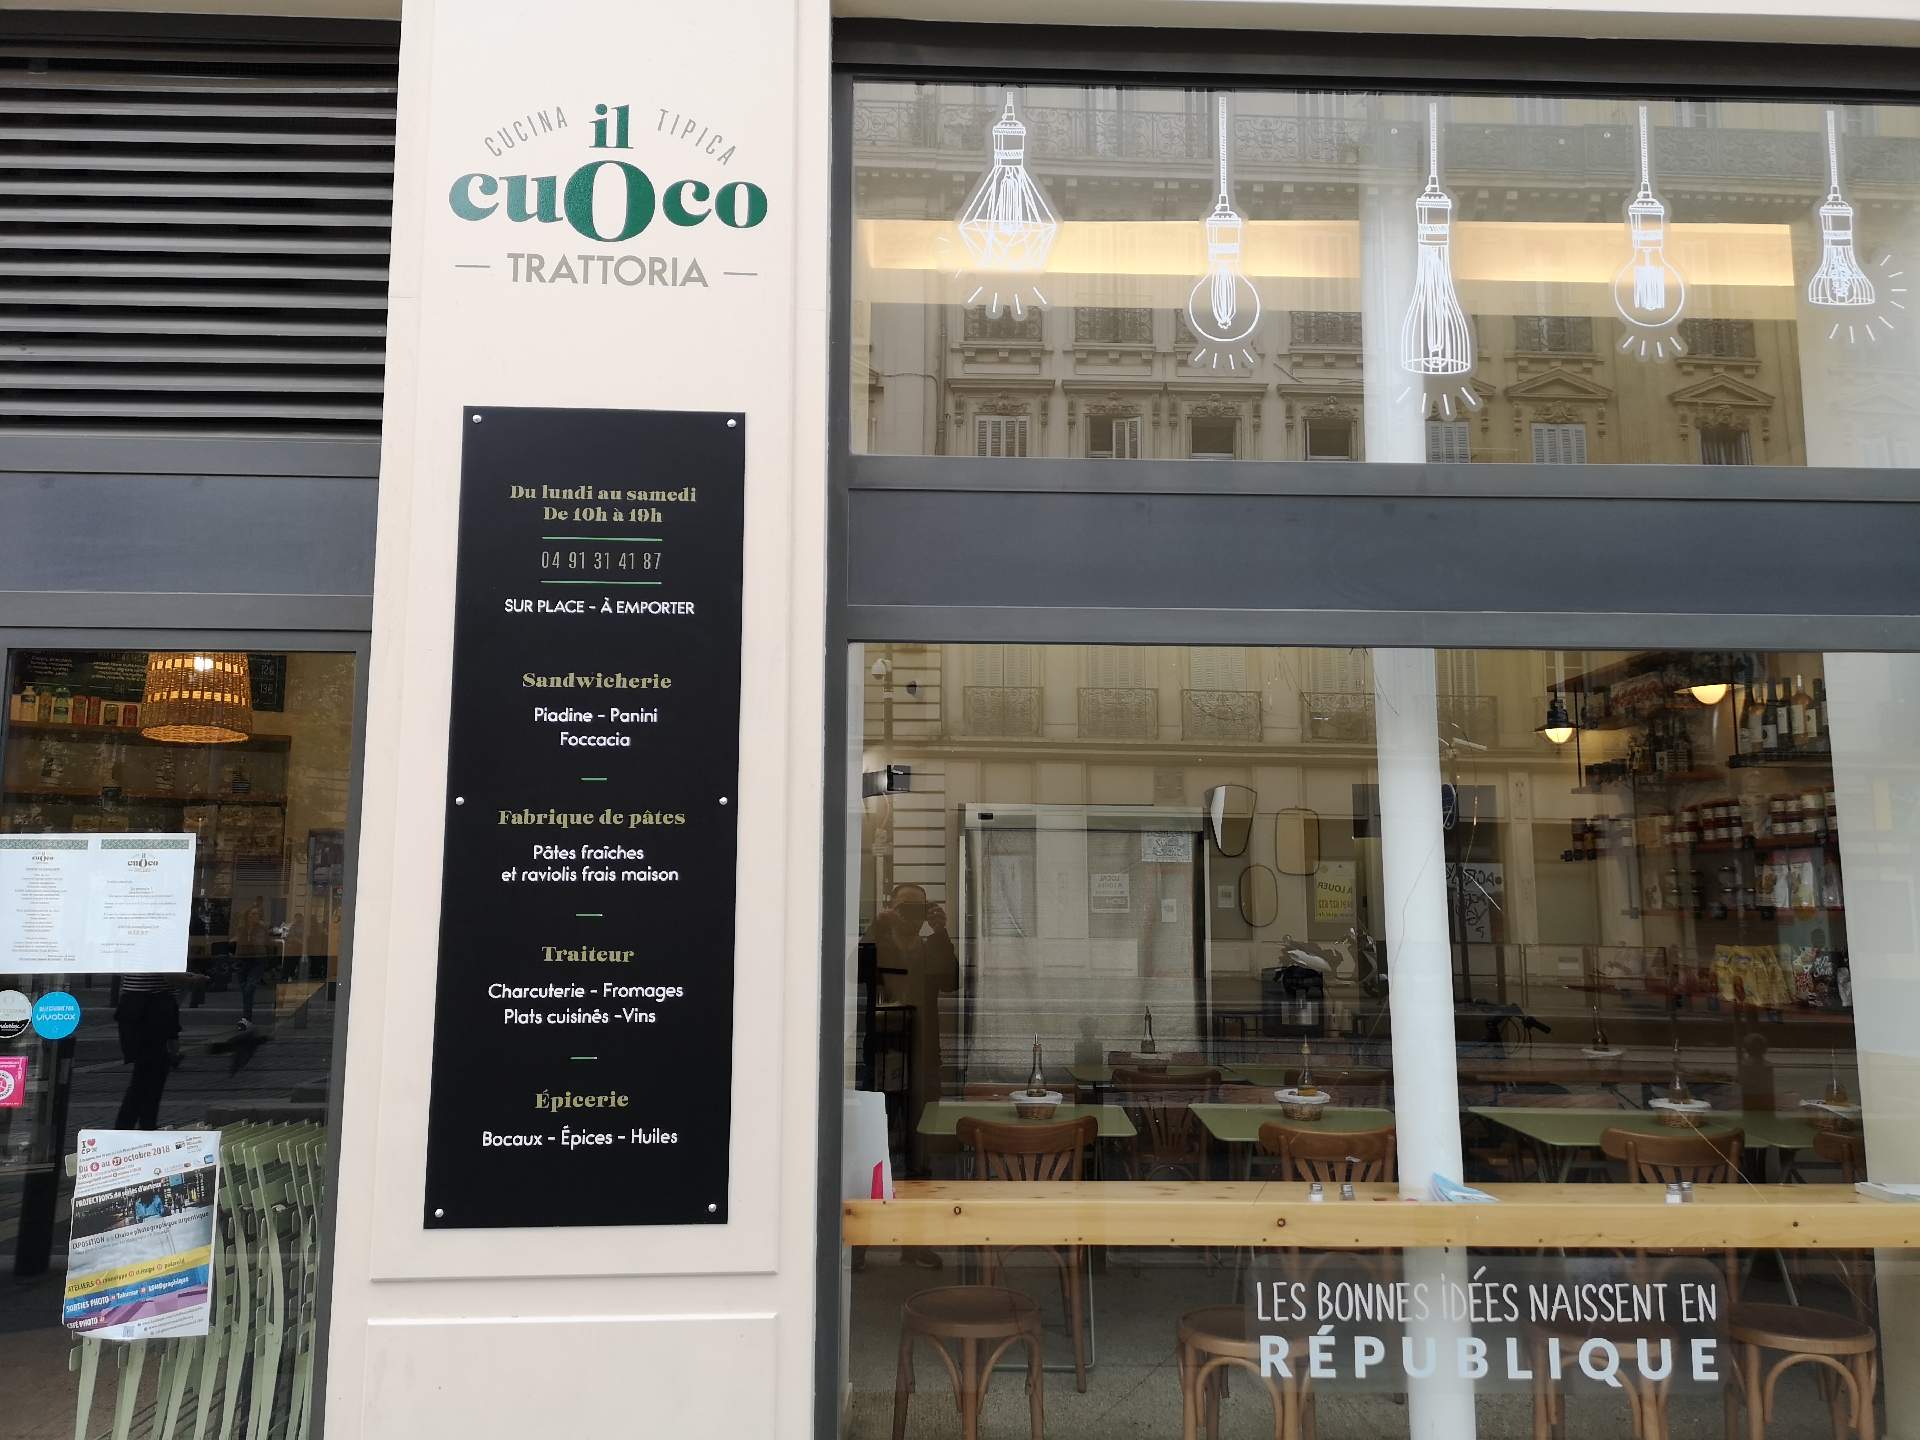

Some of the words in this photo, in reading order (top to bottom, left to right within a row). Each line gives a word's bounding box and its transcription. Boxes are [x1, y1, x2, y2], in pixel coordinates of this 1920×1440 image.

[484, 105, 569, 157] CUCINA
[589, 103, 634, 150] il
[657, 108, 738, 166] TIPICA
[506, 252, 709, 288] TRATTORIA
[509, 485, 537, 499] Du
[541, 484, 593, 500] lundi
[597, 489, 623, 500] au
[626, 486, 697, 502] samedi
[543, 506, 569, 521] De
[572, 506, 608, 522] 10h
[612, 507, 625, 522] à
[628, 507, 663, 523] 19h
[541, 551, 560, 569] 04
[568, 551, 585, 569] 91
[593, 551, 610, 570] 31
[618, 552, 635, 570] 41
[643, 552, 662, 570] 87
[504, 598, 534, 613] SUR
[537, 599, 585, 614] PLACE
[600, 596, 613, 614] À
[616, 600, 695, 615] EMPORTER
[522, 672, 672, 689] Sandwicherie
[534, 706, 594, 723] Piadine
[610, 707, 658, 723] Panini
[560, 731, 631, 747] Foccacia
[497, 808, 595, 829] Fabrique
[598, 808, 624, 825] de
[628, 809, 686, 829] pâtes
[533, 844, 577, 860] Pâtes
[580, 844, 645, 860] fraîches
[501, 866, 518, 882] et
[521, 865, 577, 882] raviolis
[581, 865, 617, 882] frais
[621, 865, 679, 882] maison
[541, 945, 635, 963] Traiteur
[487, 982, 585, 999] Charcuterie
[603, 982, 684, 1003] Fromages
[504, 1008, 543, 1025] Plats
[546, 1007, 609, 1025] cuisinés
[535, 1088, 629, 1113] Épicerie
[482, 1130, 543, 1147] Bocaux
[561, 1124, 613, 1151] Épices
[631, 1127, 678, 1145] Huiles
[79, 1165, 89, 1173] Du
[101, 1160, 110, 1168] au
[123, 1151, 151, 1163] octobre
[152, 1145, 170, 1156] 2018
[75, 1192, 113, 1207] PROJECTIONS
[66, 1301, 89, 1312] SORTIES
[90, 1296, 109, 1306] PHOTO
[1256, 1281, 1306, 1323] LES
[1316, 1281, 1429, 1323] BONNES
[1528, 1282, 1669, 1323] NAISSENT
[1681, 1283, 1718, 1323] EN
[1259, 1324, 1720, 1388] RÉPUBLIQUE
